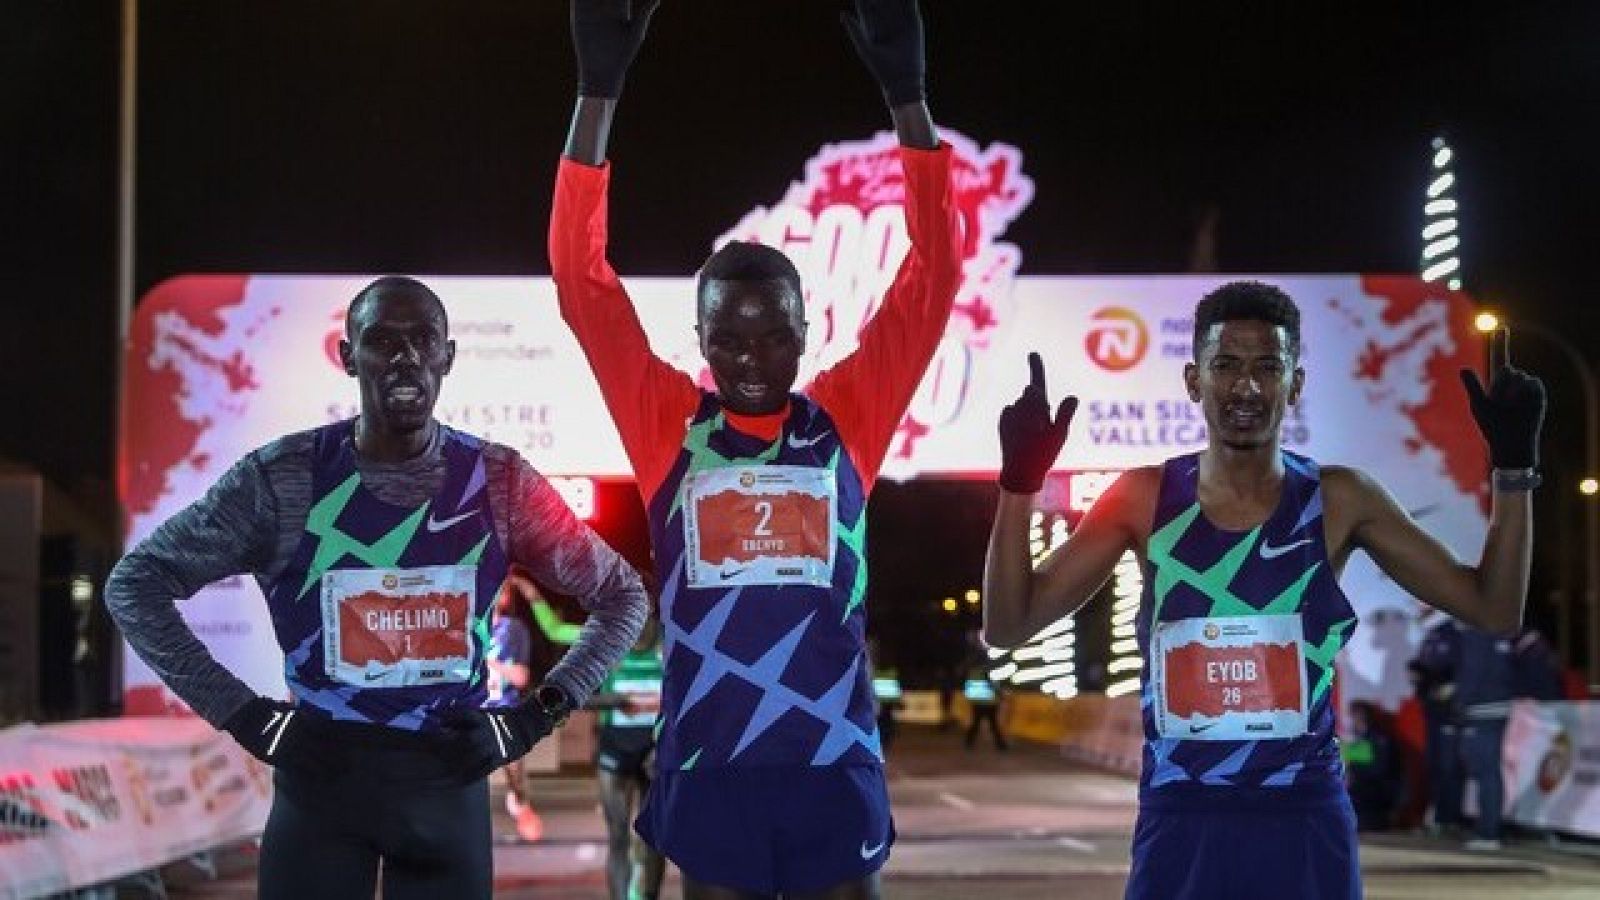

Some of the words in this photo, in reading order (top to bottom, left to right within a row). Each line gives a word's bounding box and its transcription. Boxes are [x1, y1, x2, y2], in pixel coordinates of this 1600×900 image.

[1089, 402, 1145, 420] SAN
[1089, 427, 1206, 445] VALLECA
[754, 502, 773, 536] 2
[366, 609, 449, 631] CHELIMO
[404, 634, 412, 652] 1
[1206, 660, 1257, 684] EYOB
